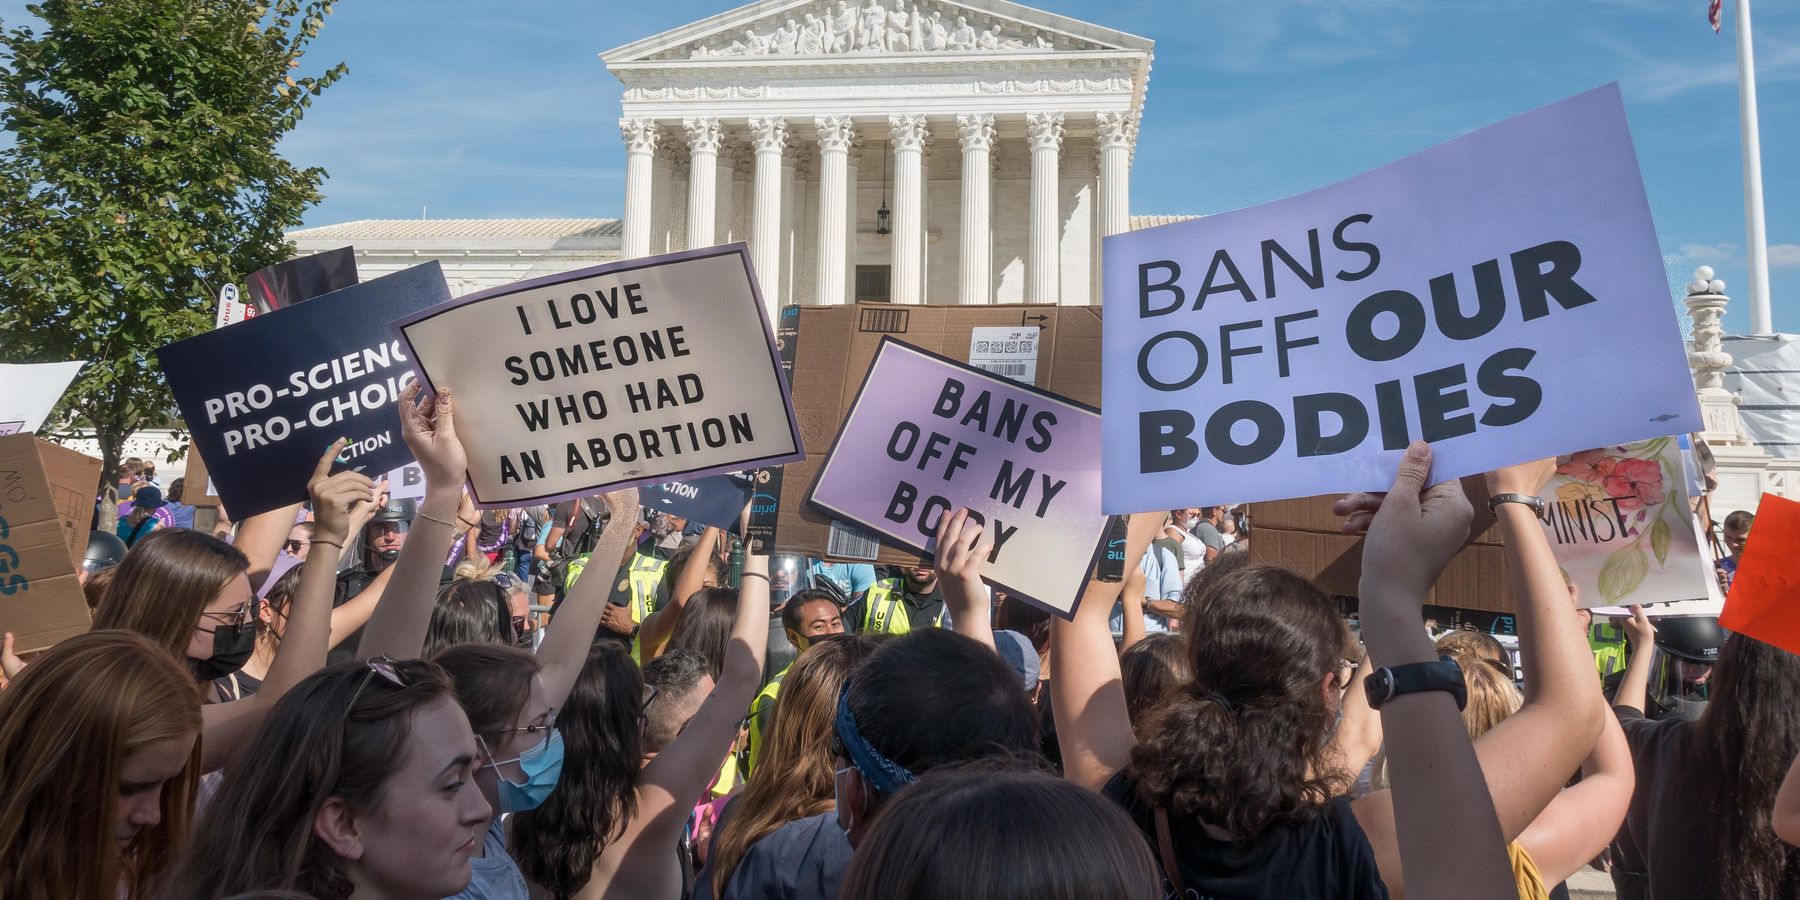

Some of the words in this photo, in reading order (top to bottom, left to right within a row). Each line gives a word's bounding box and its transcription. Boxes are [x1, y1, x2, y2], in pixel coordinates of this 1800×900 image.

[1138, 213, 1381, 319] BANS
[517, 305, 533, 336] I
[547, 282, 649, 330] LOVE
[1136, 308, 1320, 392] OFF
[1345, 240, 1598, 362] OUR
[504, 325, 691, 386] SOMEONE
[515, 390, 608, 433] WHO
[624, 373, 704, 414] HAD
[932, 377, 1058, 453] BANS
[1138, 347, 1543, 474] BODIES
[500, 449, 546, 485] AN
[566, 412, 754, 474] ABORTION
[886, 421, 978, 482] OFF
[988, 458, 1067, 518] MY
[883, 480, 1018, 564] BODY
